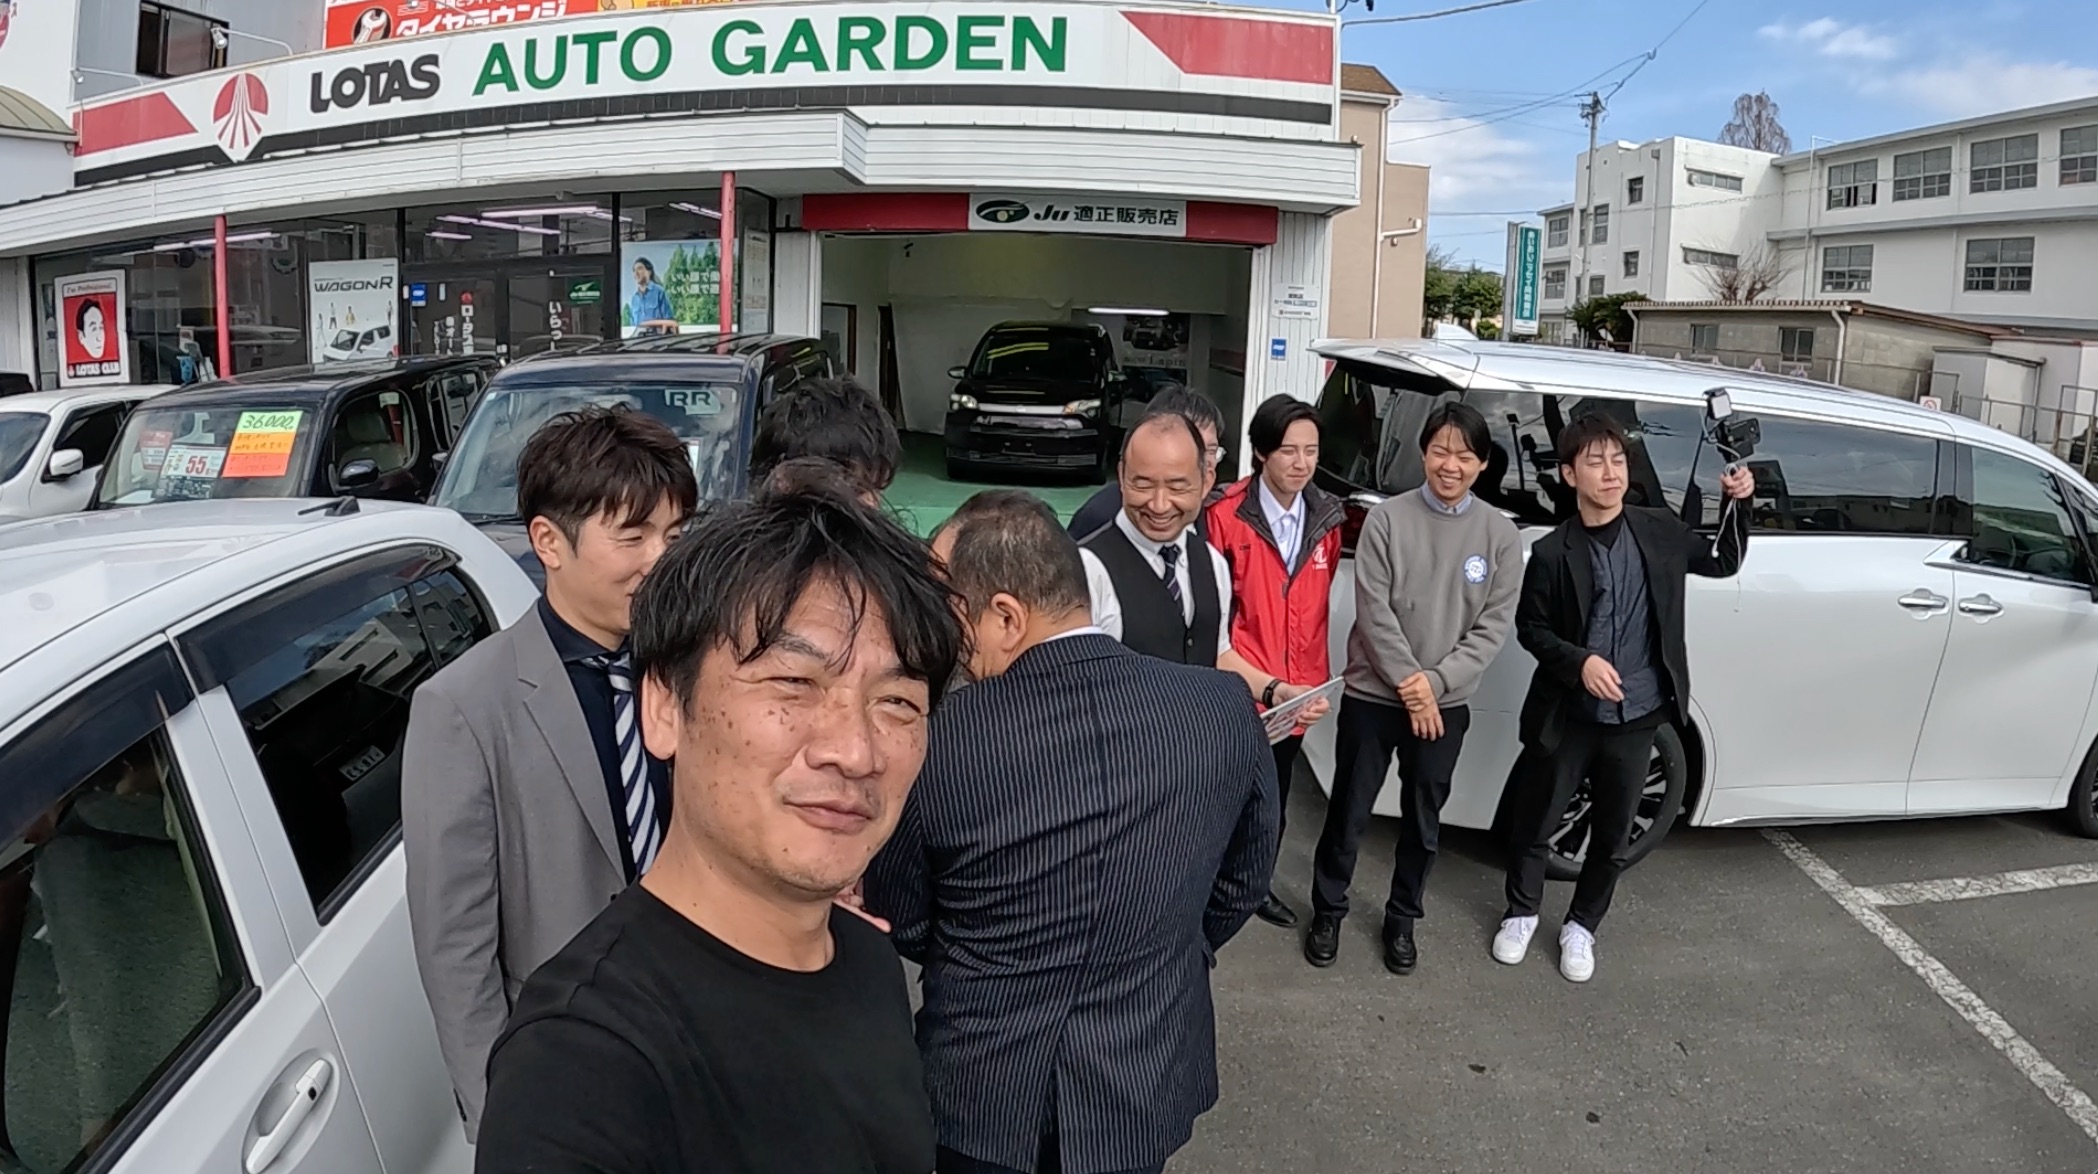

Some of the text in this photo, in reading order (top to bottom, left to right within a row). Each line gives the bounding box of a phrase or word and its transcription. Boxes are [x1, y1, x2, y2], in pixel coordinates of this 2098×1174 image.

[310, 15, 1068, 114] LOTAS AUTO GARDEN
[1073, 205, 1179, 226] 適正販売店
